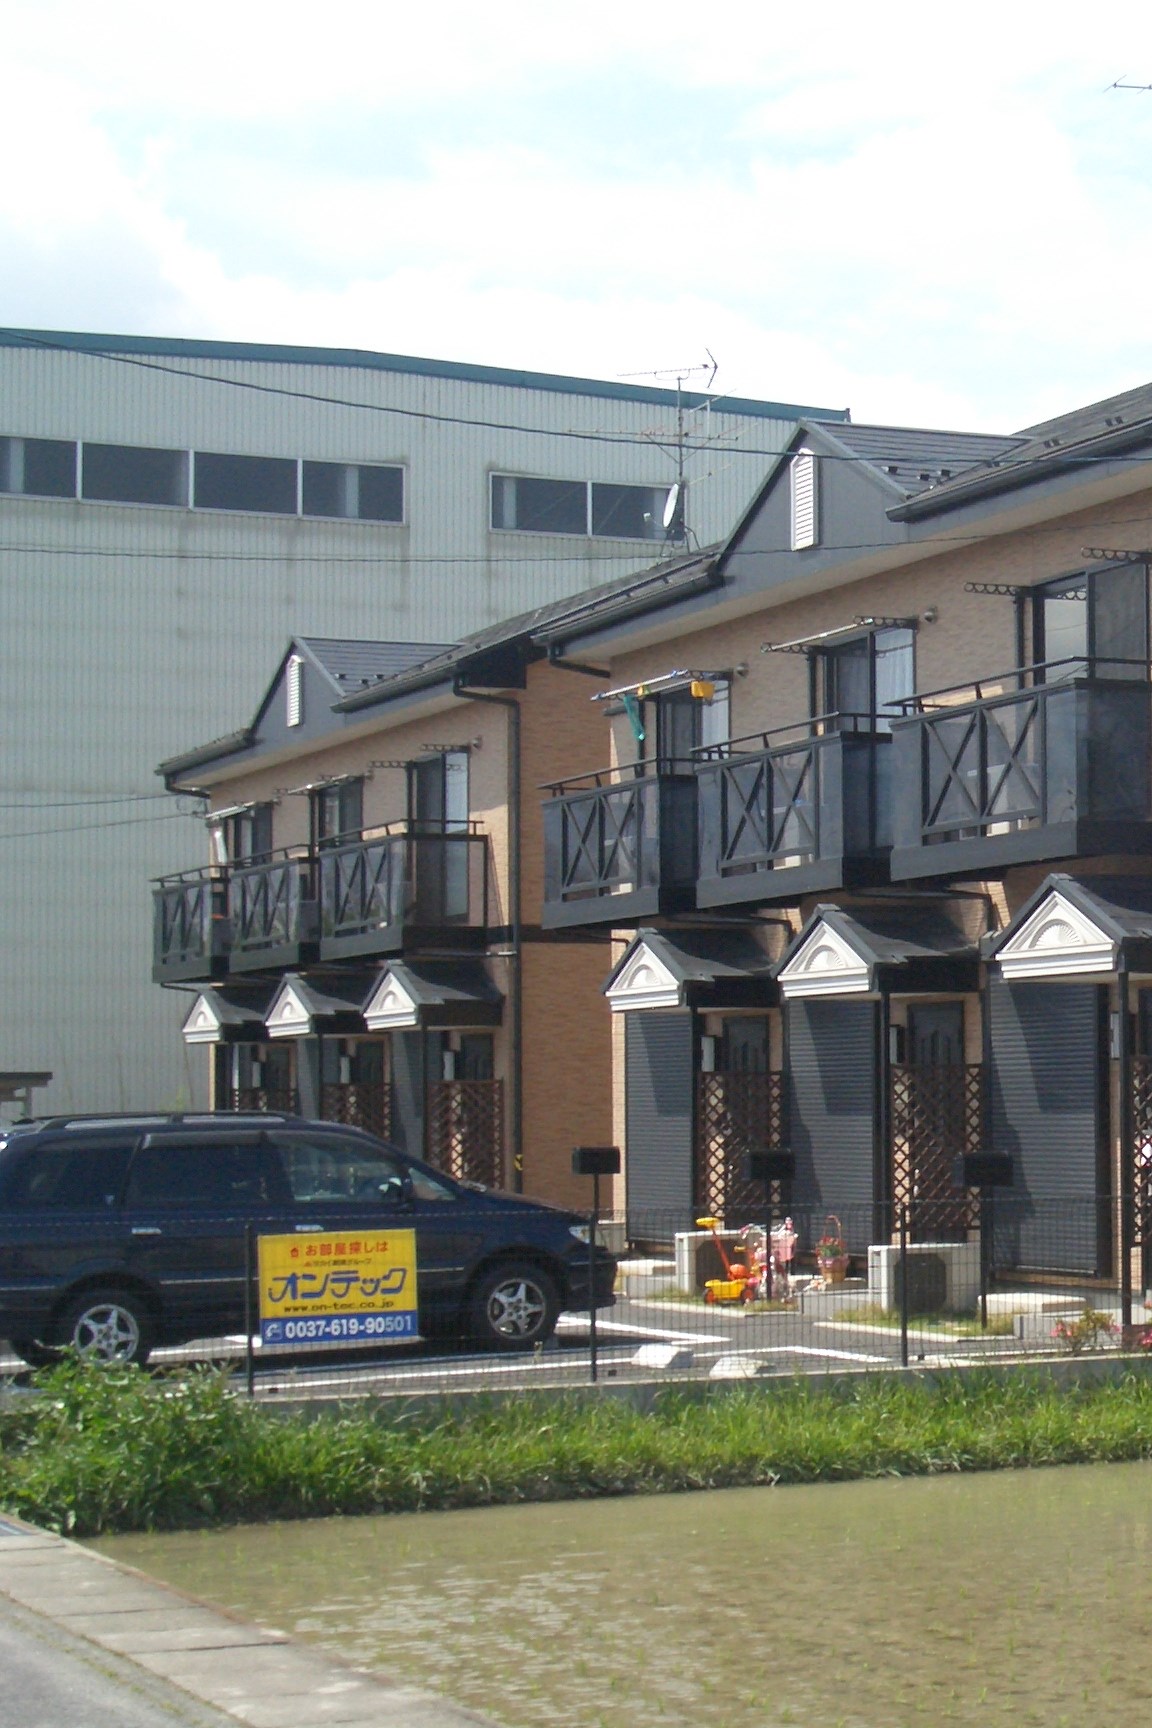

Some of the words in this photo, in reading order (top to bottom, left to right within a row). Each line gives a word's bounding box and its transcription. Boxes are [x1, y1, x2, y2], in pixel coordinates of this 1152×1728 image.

[268, 1267, 408, 1303] オンテック
[284, 1298, 395, 1313] www.on-tec.co.jp
[285, 1315, 413, 1340] 0037-619-90501
